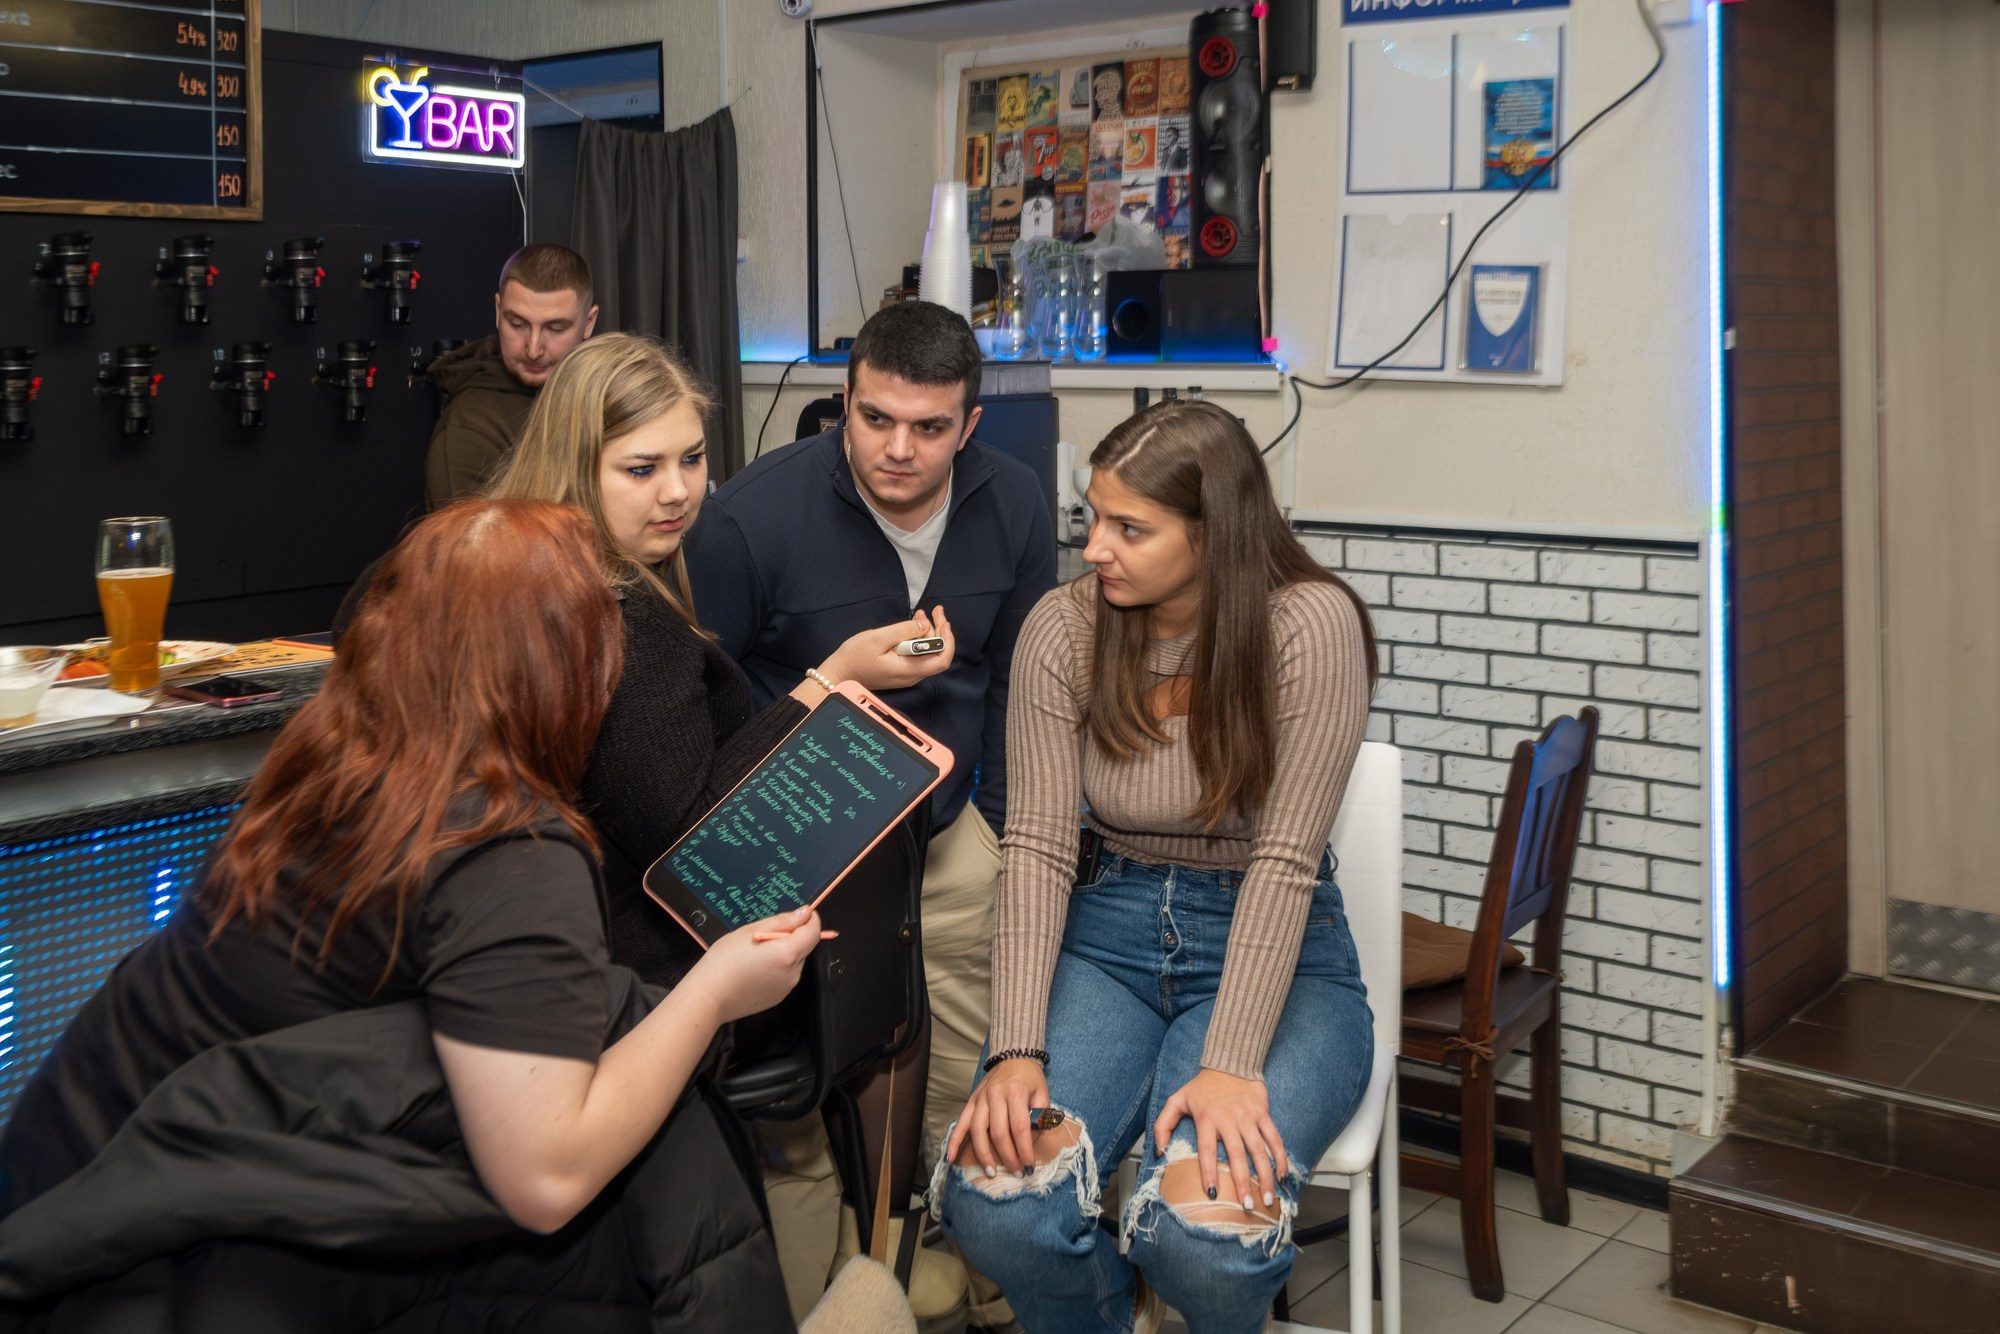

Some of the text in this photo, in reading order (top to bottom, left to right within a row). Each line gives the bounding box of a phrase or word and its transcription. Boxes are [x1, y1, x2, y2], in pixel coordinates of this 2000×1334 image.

[216, 29, 238, 52] 320
[216, 74, 240, 98] 300
[216, 124, 240, 146] 150
[427, 96, 515, 154] BAR
[218, 173, 241, 197] 150
